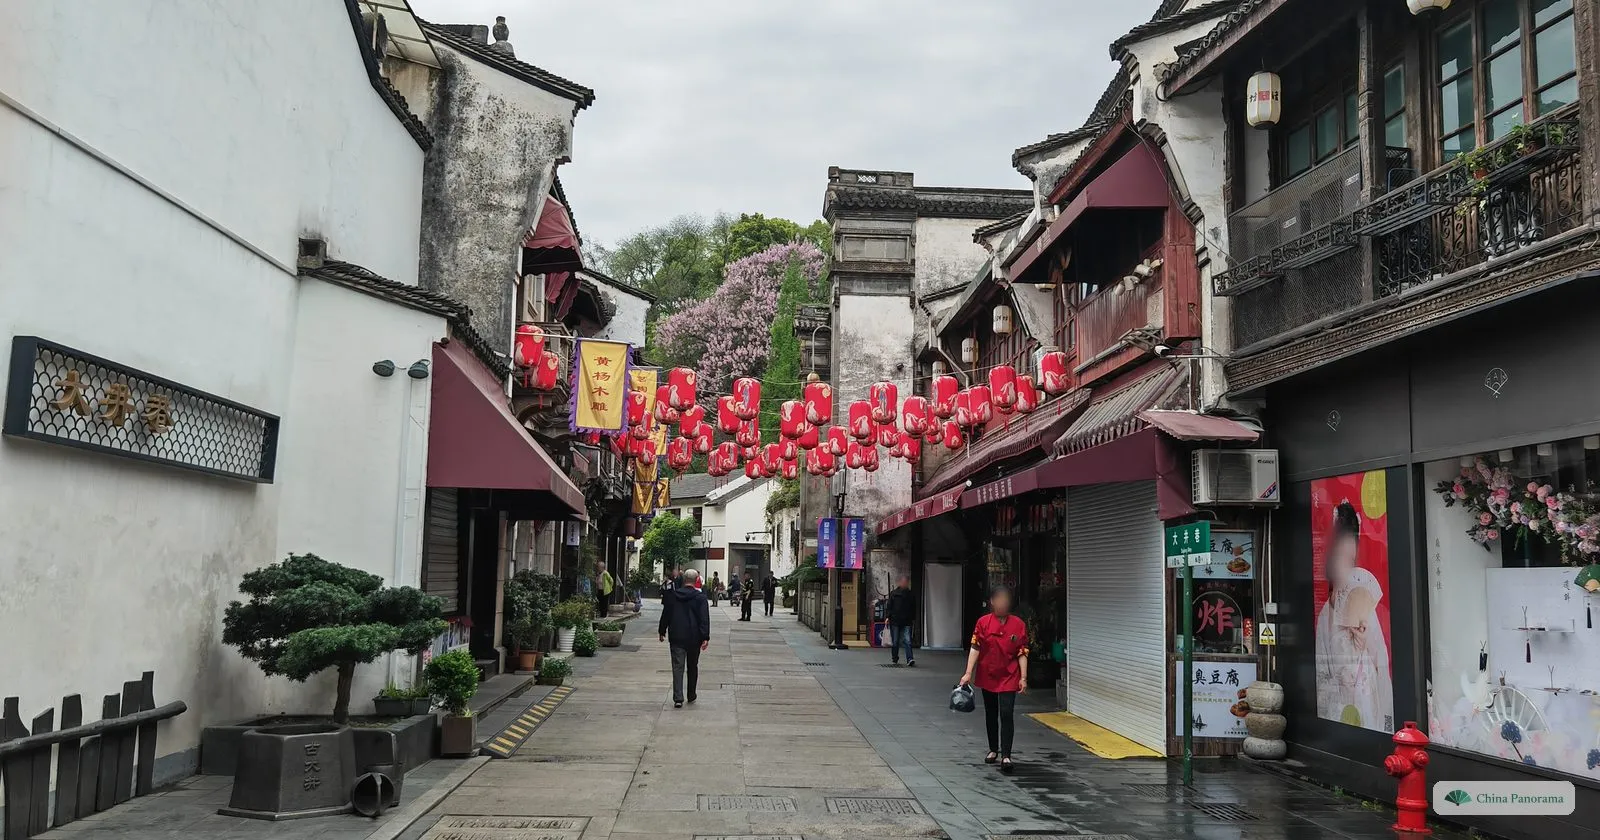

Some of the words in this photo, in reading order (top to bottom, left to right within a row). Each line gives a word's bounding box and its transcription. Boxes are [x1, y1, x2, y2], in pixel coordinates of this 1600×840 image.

[50, 368, 175, 434] 大井巷
[591, 356, 612, 412] 黄杨木雕
[1172, 527, 1200, 546] 大井巷
[1196, 598, 1235, 636] 炸
[1192, 668, 1240, 687] 臭豆腐
